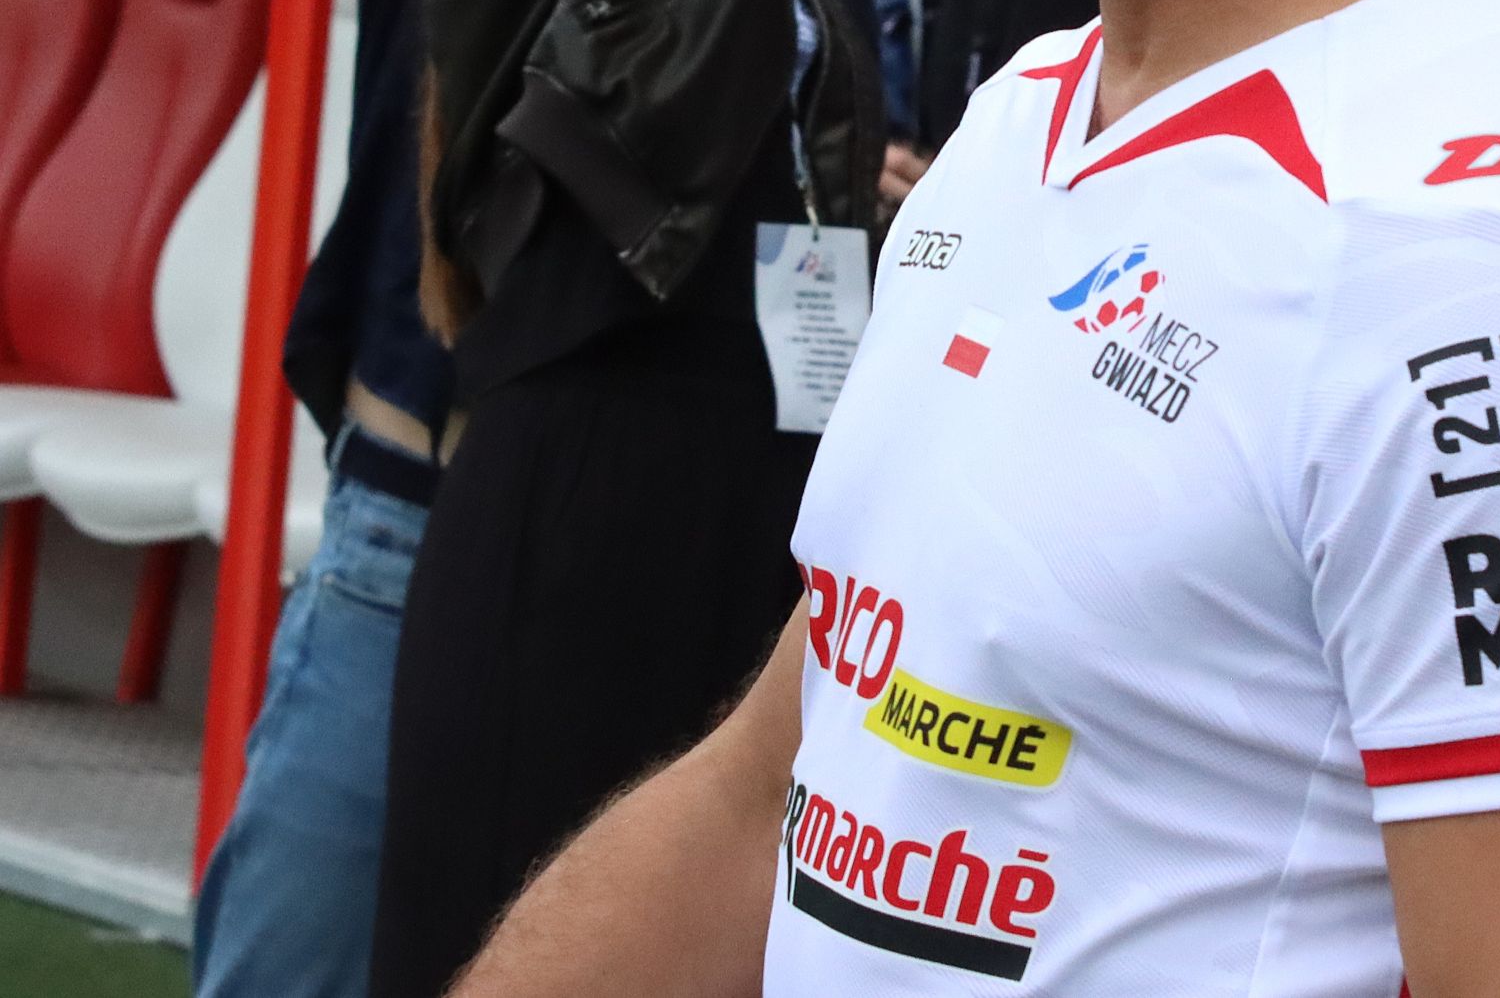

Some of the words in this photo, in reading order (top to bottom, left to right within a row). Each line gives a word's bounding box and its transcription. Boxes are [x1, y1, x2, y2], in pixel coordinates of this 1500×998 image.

[1091, 340, 1191, 424] GWIAZD
[1139, 311, 1219, 383] MECZ
[797, 561, 904, 700] RICO
[881, 682, 1047, 772] MARCHÉ
